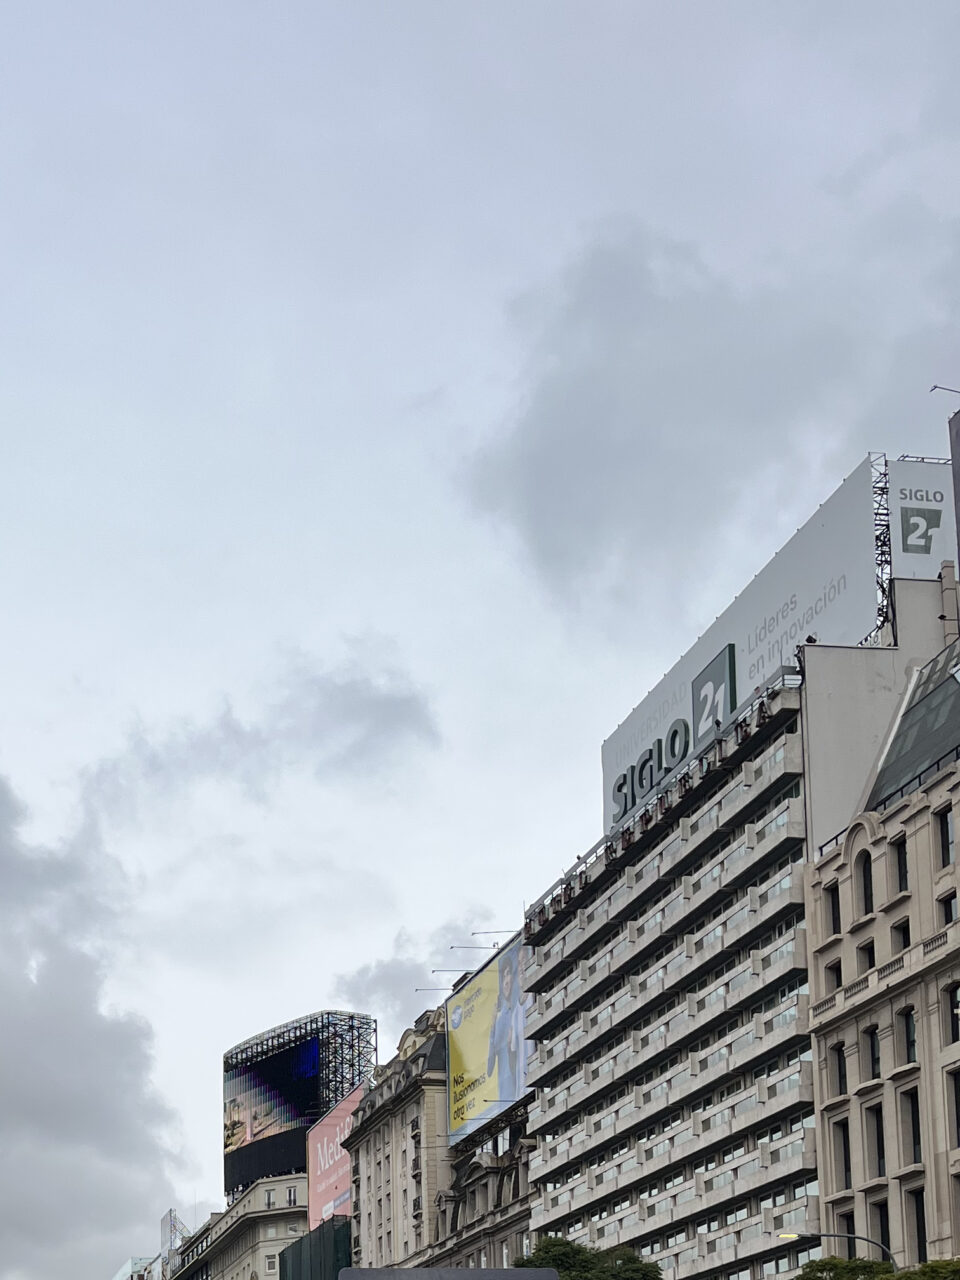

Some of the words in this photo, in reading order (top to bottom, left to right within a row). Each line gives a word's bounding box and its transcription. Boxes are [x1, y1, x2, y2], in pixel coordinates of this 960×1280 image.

[899, 488, 944, 503] SIGLO
[747, 593, 797, 655] Líderes
[749, 655, 765, 680] en
[768, 573, 846, 662] innovación
[612, 718, 690, 823] SIGLO
[698, 681, 725, 738] 21
[615, 681, 687, 765] UNIVERSIDAD
[453, 1073, 464, 1089] Nos
[453, 1073, 487, 1104] ilusionamos
[453, 1103, 465, 1120] otra
[465, 1097, 476, 1112] vez
[317, 1115, 353, 1176] Medif
